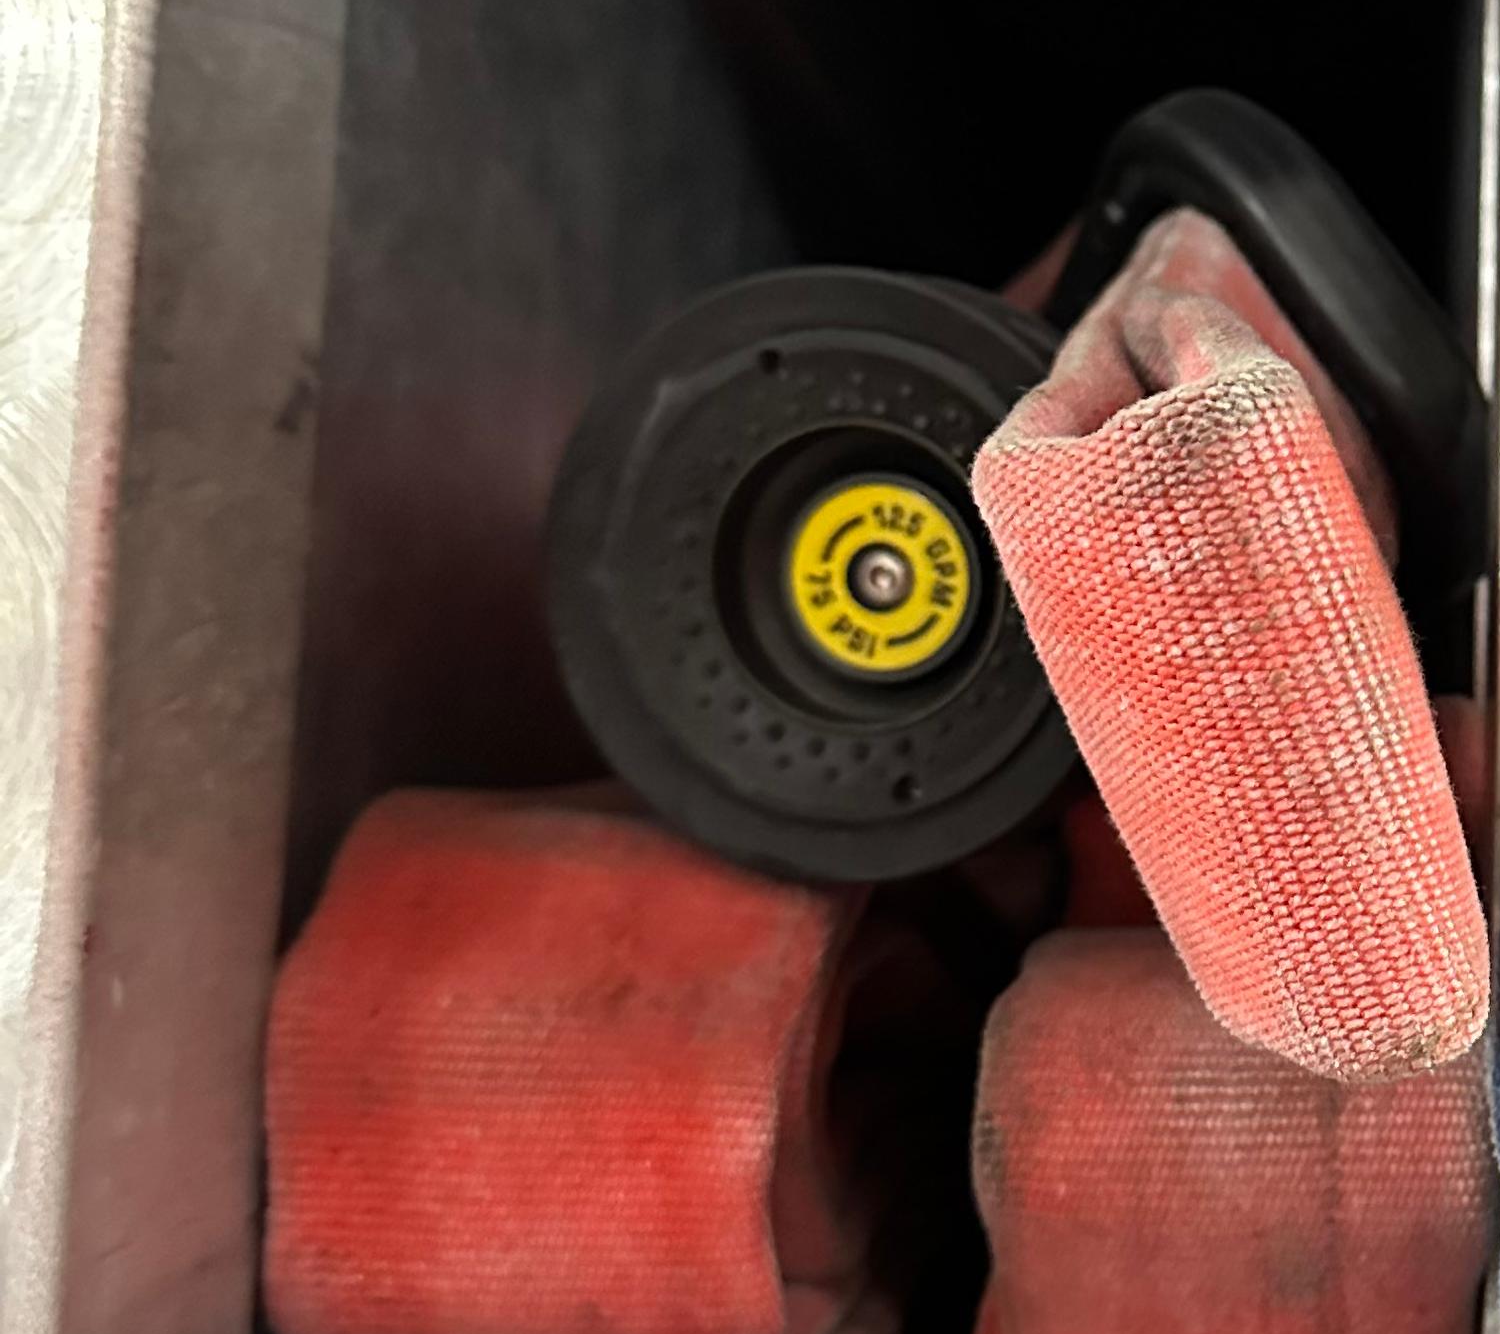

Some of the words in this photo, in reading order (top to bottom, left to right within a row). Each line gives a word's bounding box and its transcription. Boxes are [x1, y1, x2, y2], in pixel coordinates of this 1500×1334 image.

[873, 504, 926, 537] 125
[926, 538, 957, 607] GPM
[807, 570, 836, 608] 75
[830, 616, 877, 659] PSI
